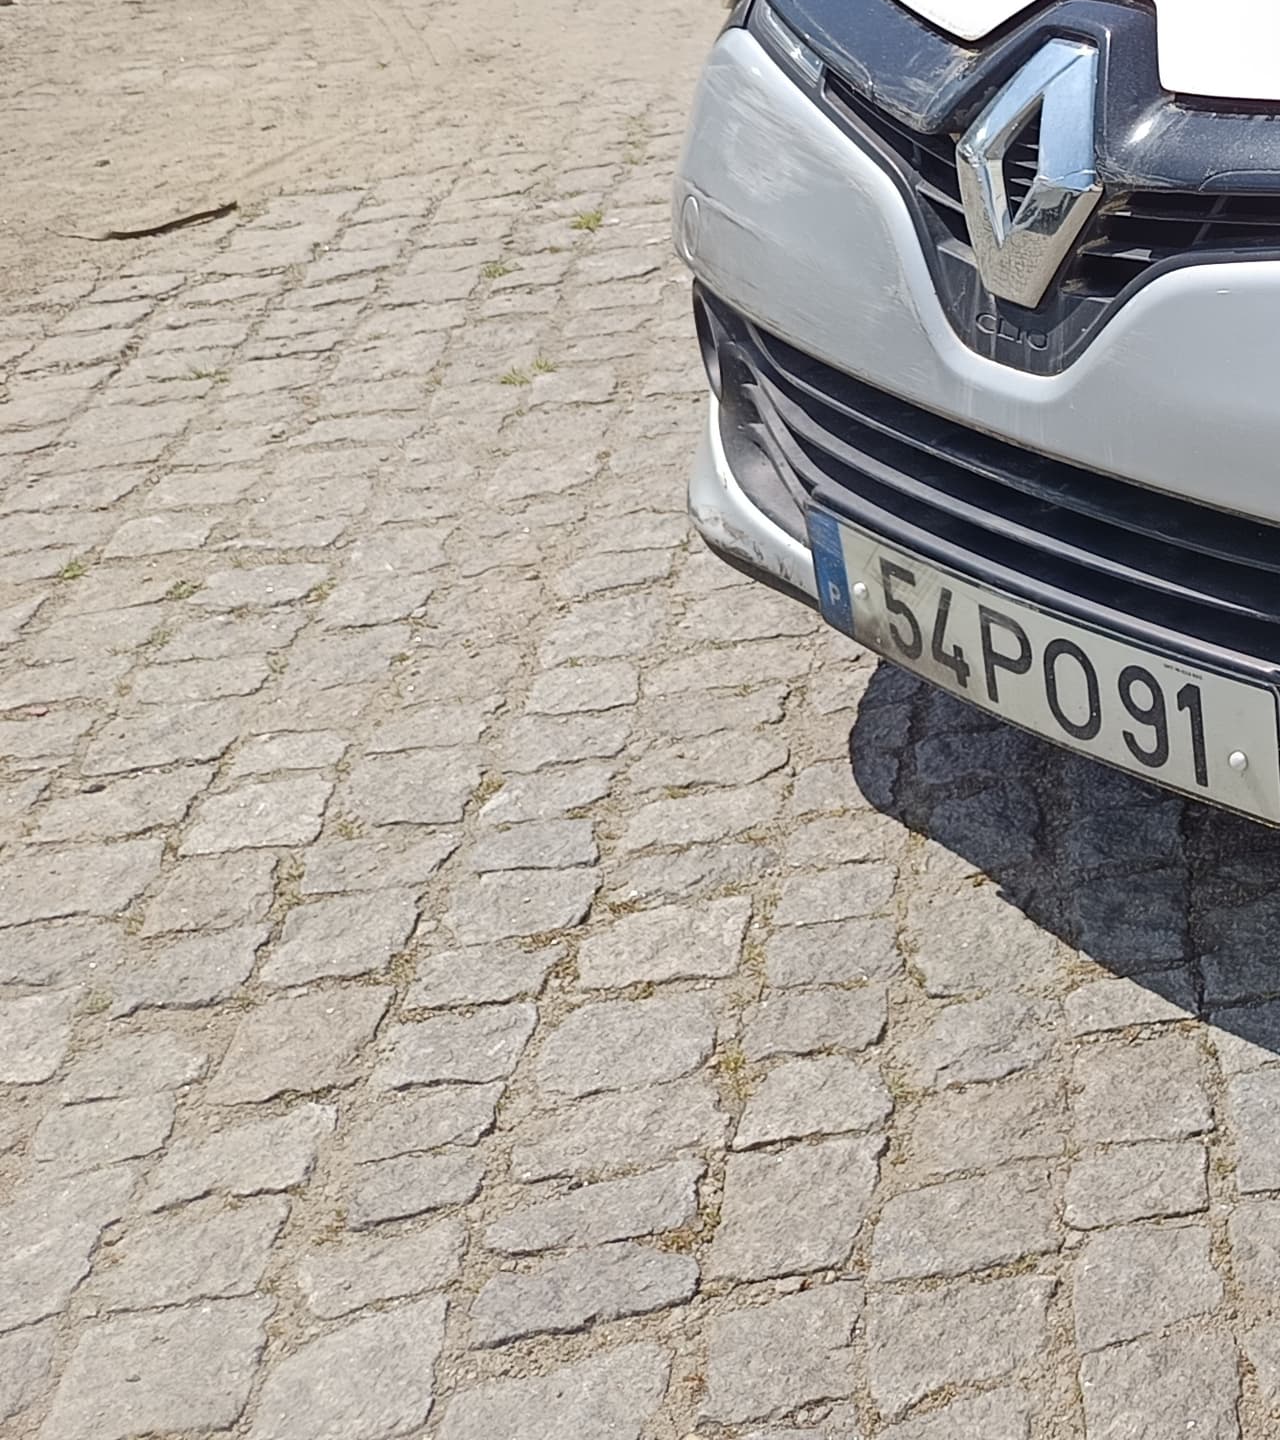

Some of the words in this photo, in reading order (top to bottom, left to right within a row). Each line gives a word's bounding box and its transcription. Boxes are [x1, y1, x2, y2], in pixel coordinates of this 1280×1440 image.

[975, 311, 1049, 351] CLIO
[828, 580, 842, 605] P
[879, 557, 1209, 788] 54PO91
